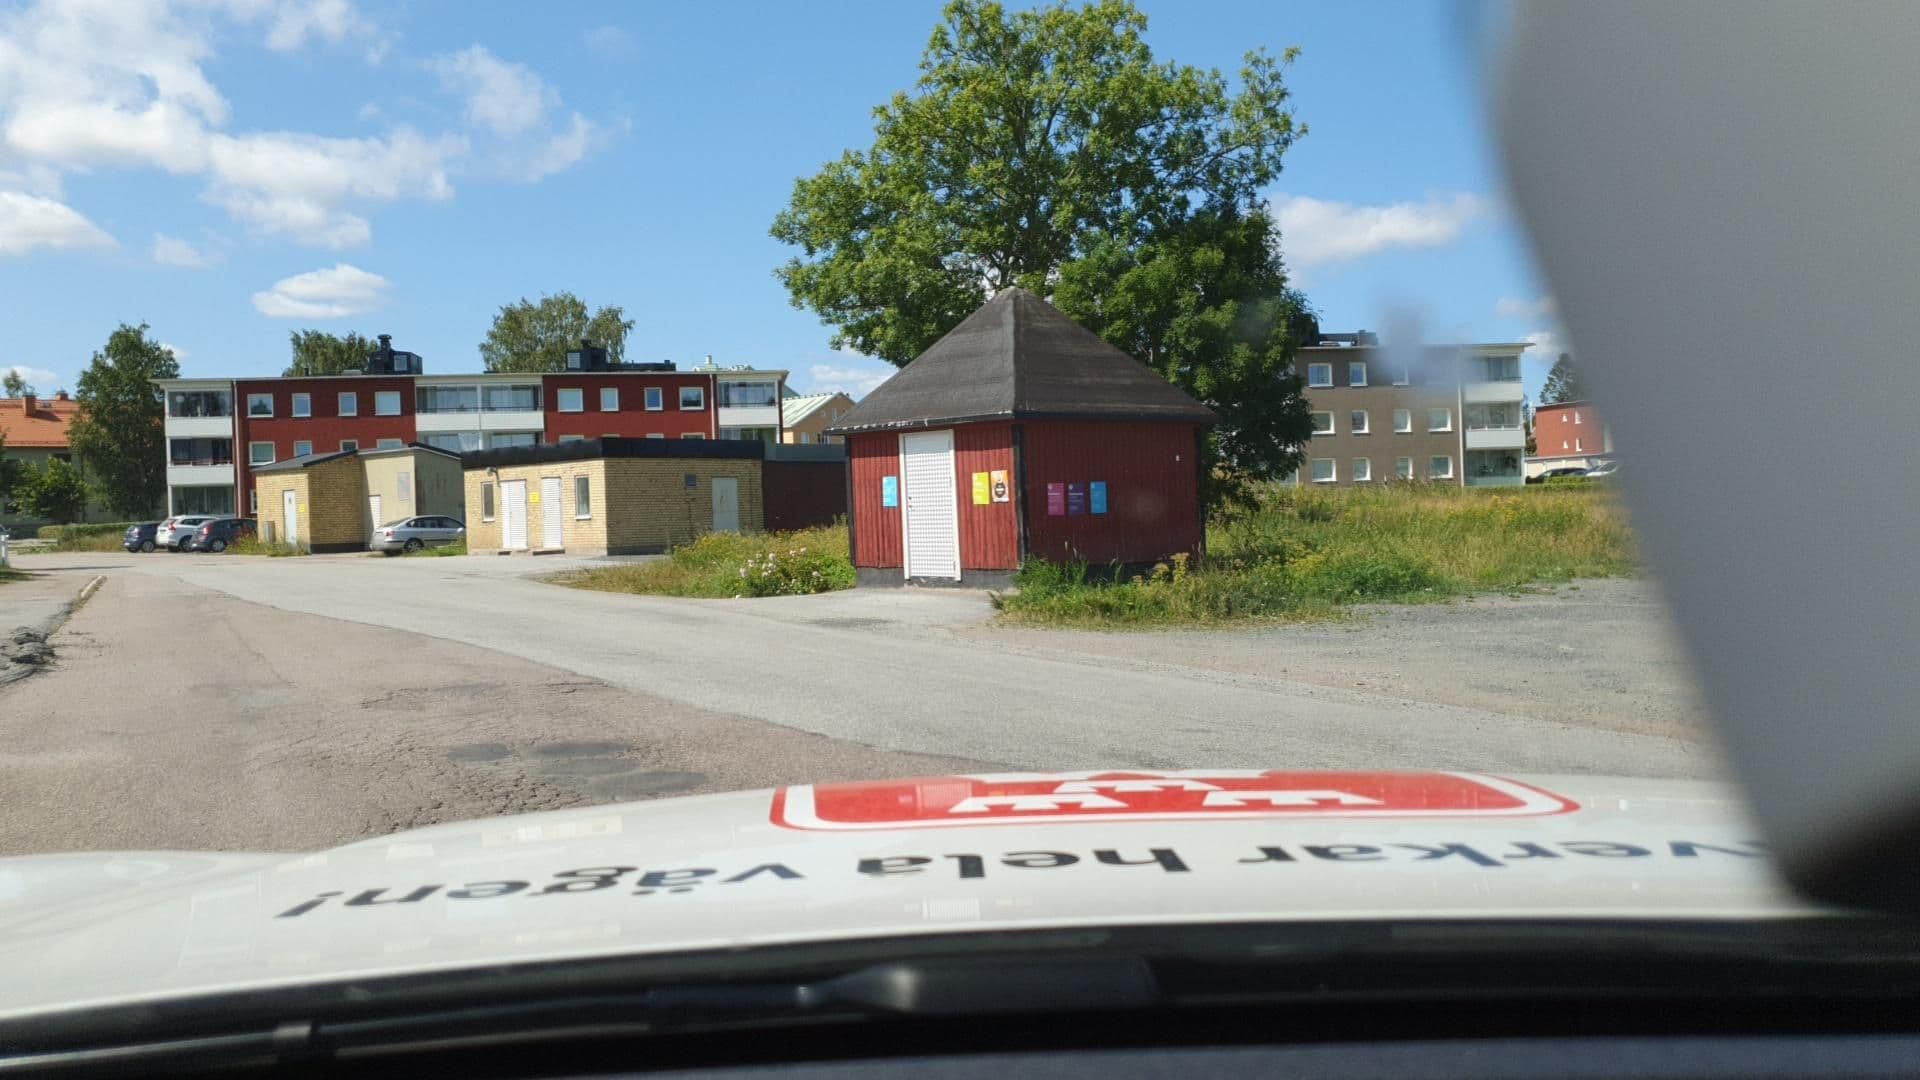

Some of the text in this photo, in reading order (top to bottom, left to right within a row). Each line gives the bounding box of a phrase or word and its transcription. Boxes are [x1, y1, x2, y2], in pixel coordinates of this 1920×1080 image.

[275, 841, 1768, 918] verkar hela vägen!
